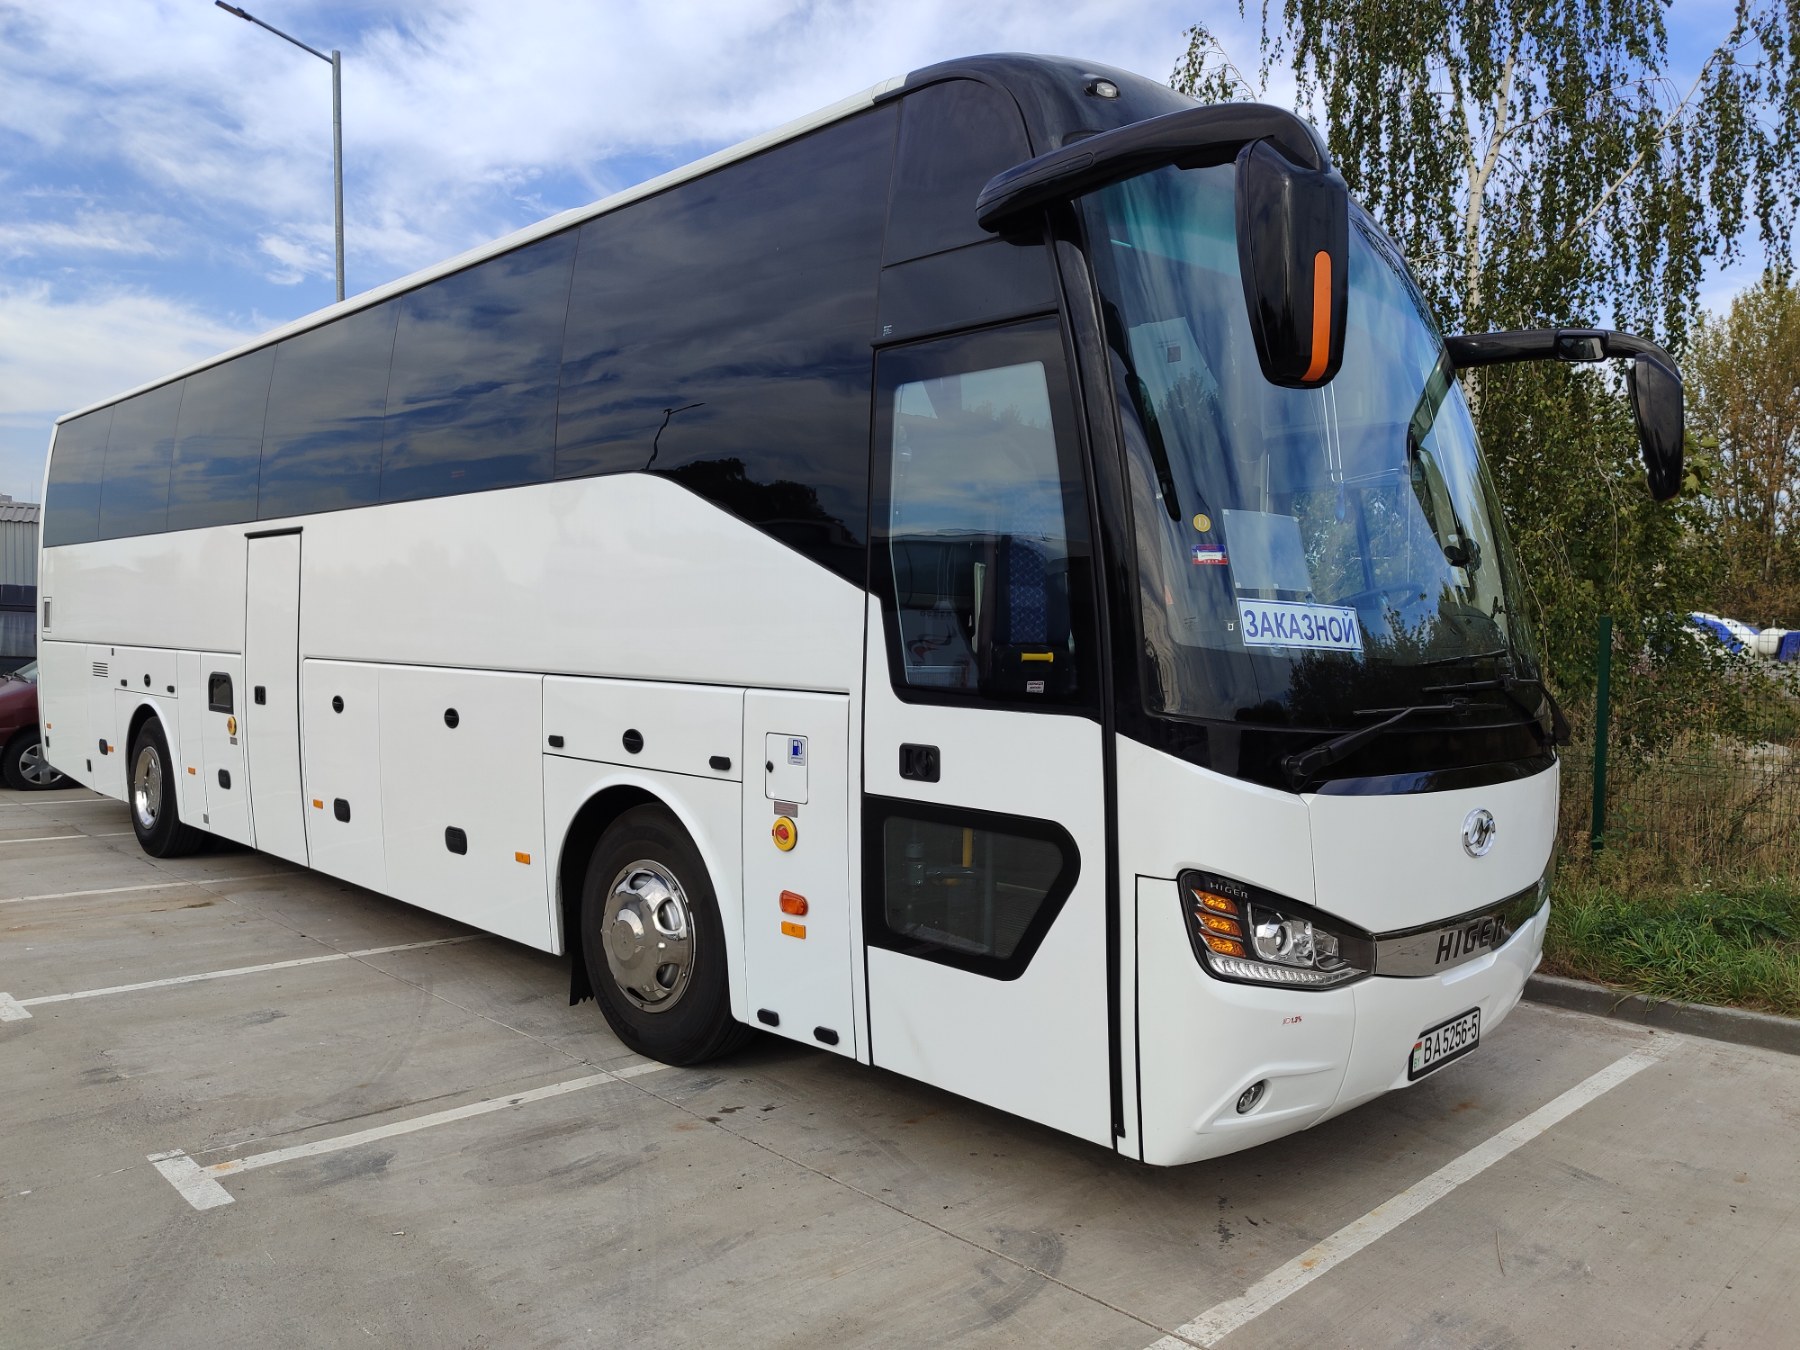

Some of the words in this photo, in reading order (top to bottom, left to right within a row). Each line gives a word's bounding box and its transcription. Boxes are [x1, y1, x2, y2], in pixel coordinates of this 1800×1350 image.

[1244, 610, 1357, 644] ЗАКАЗНОЙ
[1210, 882, 1248, 898] HIGER
[1435, 914, 1506, 964] HIGER
